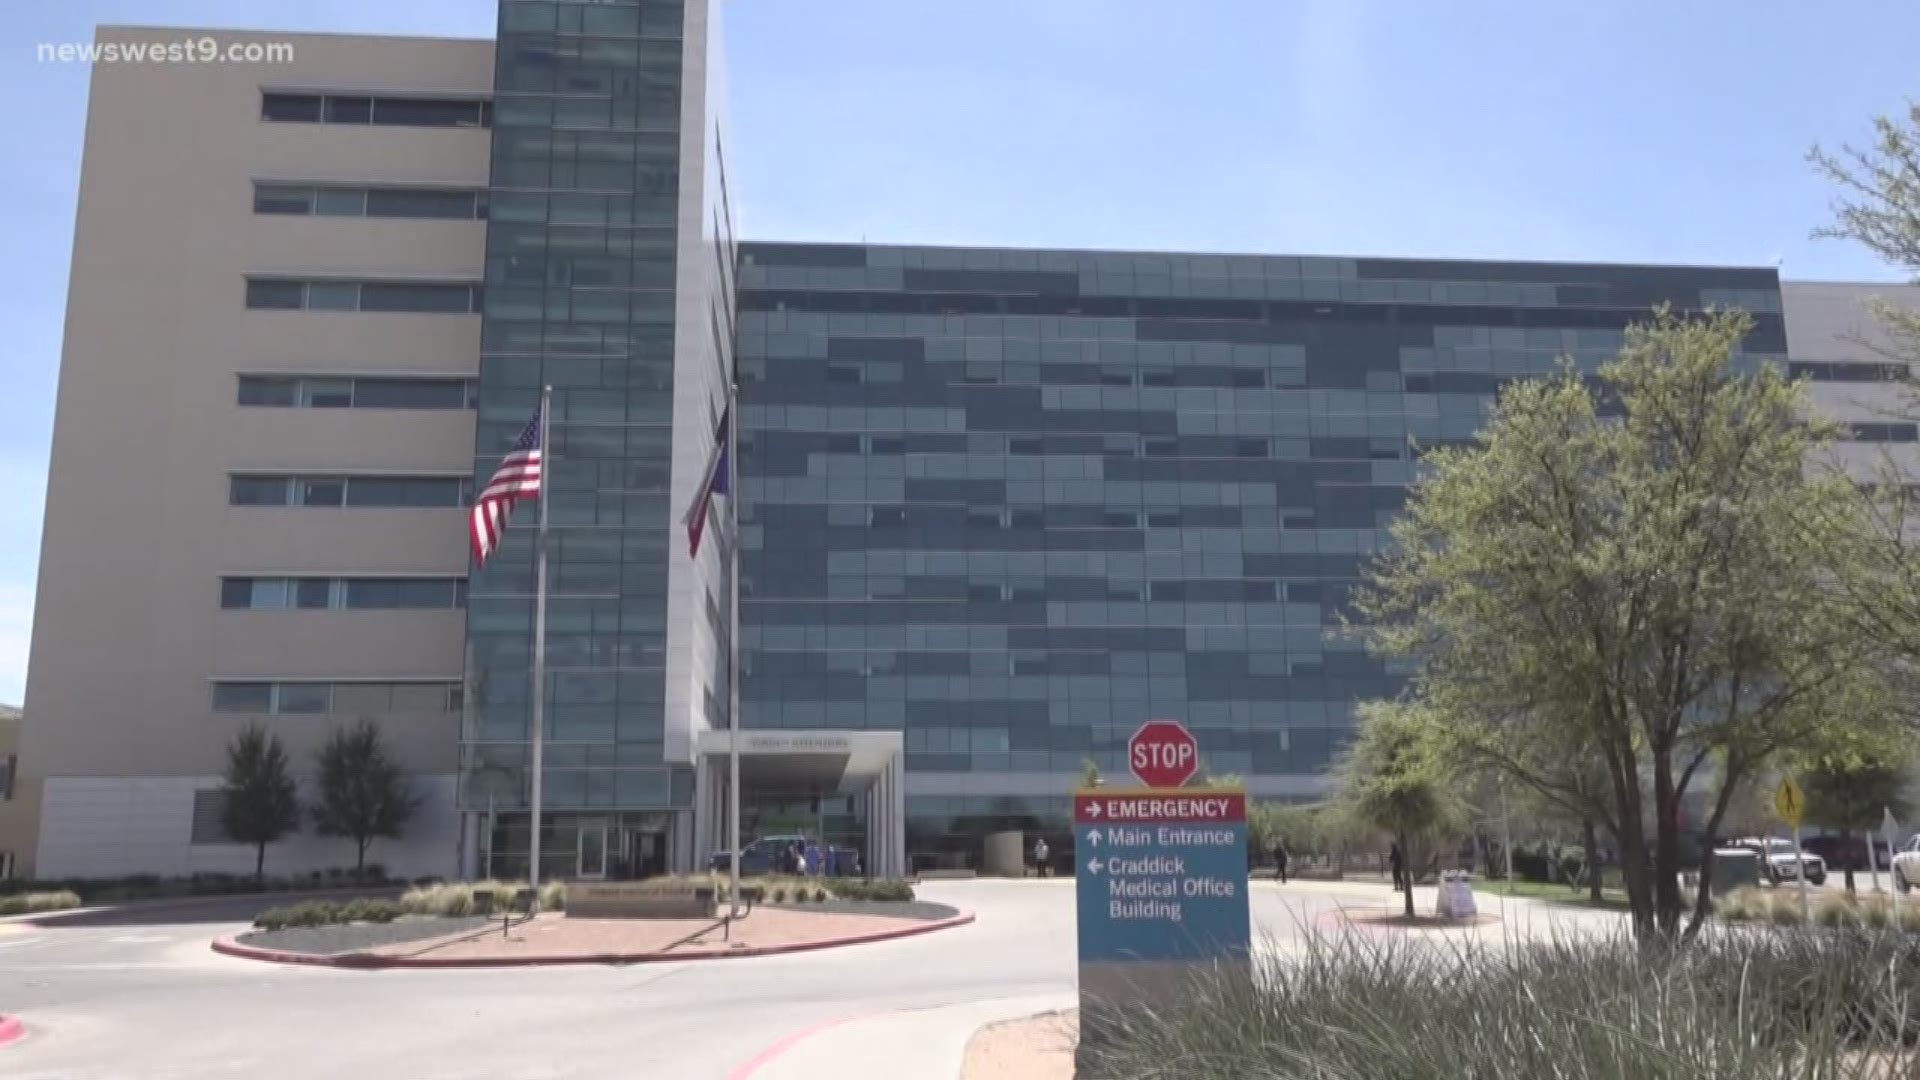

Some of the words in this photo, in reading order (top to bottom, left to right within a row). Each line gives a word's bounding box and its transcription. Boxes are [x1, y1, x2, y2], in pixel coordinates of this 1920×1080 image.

[1133, 743, 1192, 768] STOP
[1107, 799, 1229, 818] EMERGENCY
[1107, 828, 1150, 846] Main
[1157, 828, 1234, 845] Entrance
[1108, 857, 1185, 875] Craddick
[1109, 879, 1176, 897] Medical
[1184, 878, 1235, 896] Office
[1109, 900, 1181, 921] Building
